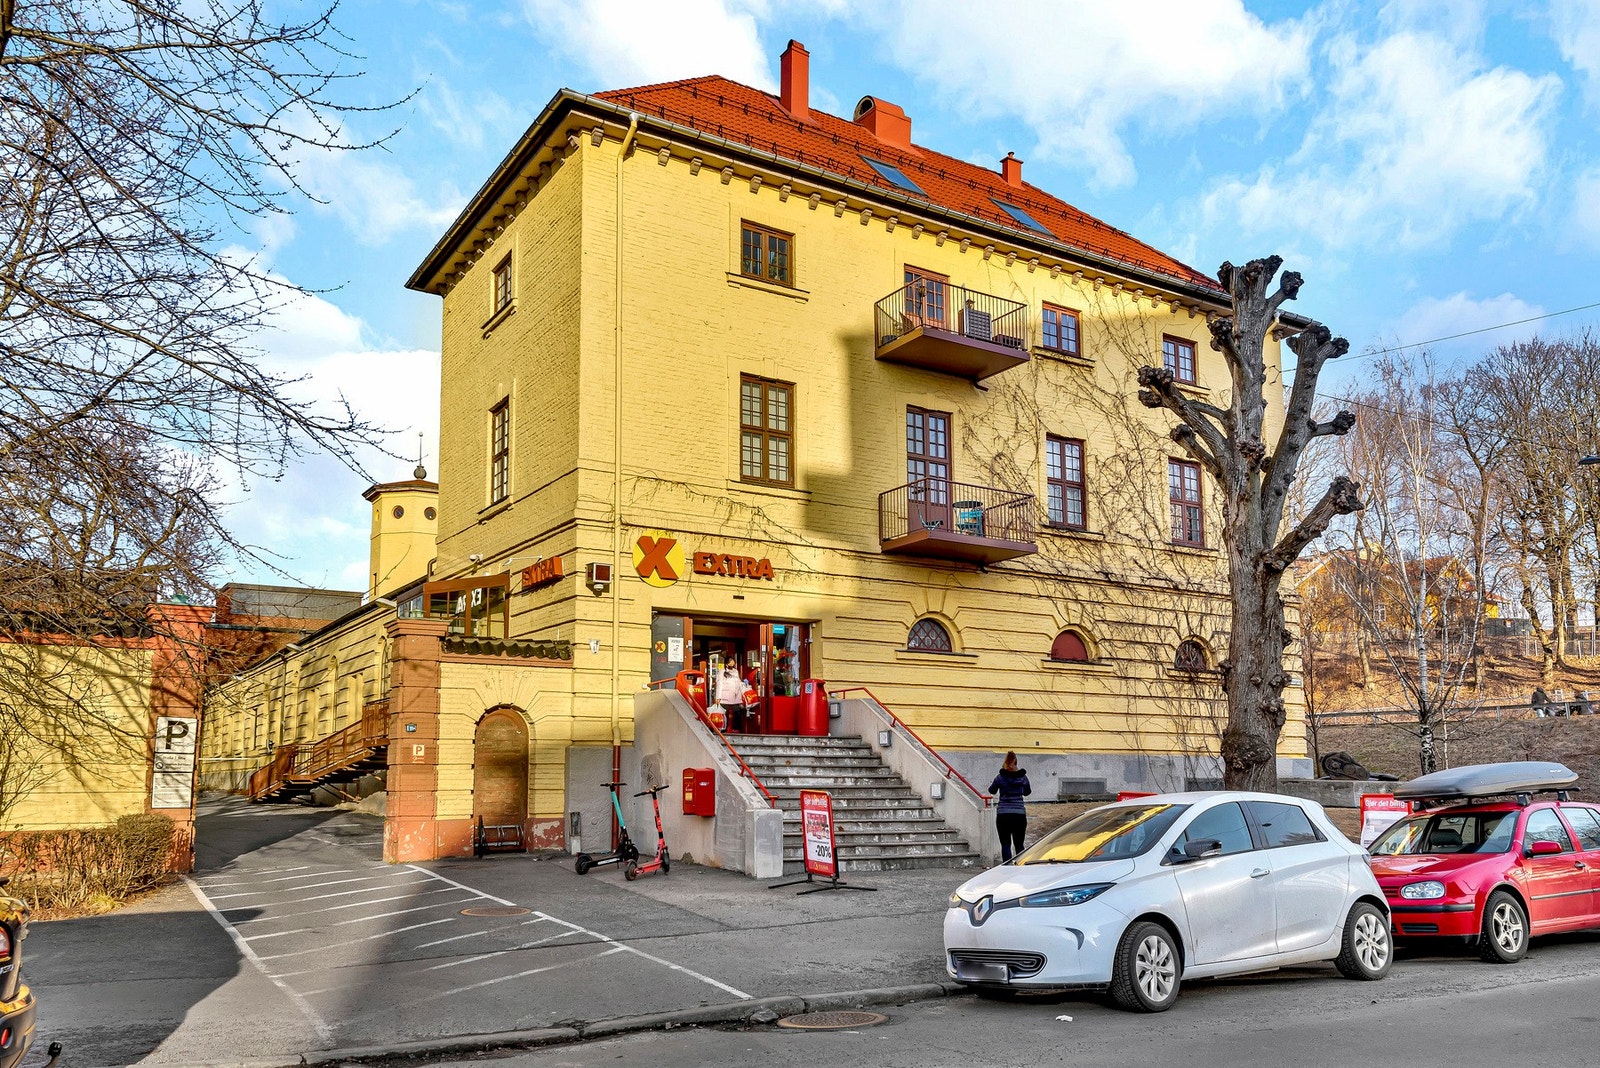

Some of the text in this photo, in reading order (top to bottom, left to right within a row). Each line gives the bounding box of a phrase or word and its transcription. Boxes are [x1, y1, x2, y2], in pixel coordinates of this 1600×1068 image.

[635, 535, 679, 580] X
[693, 551, 775, 581] EXTRA
[165, 721, 189, 749] P
[415, 746, 422, 754] P
[815, 844, 832, 859] -20%
